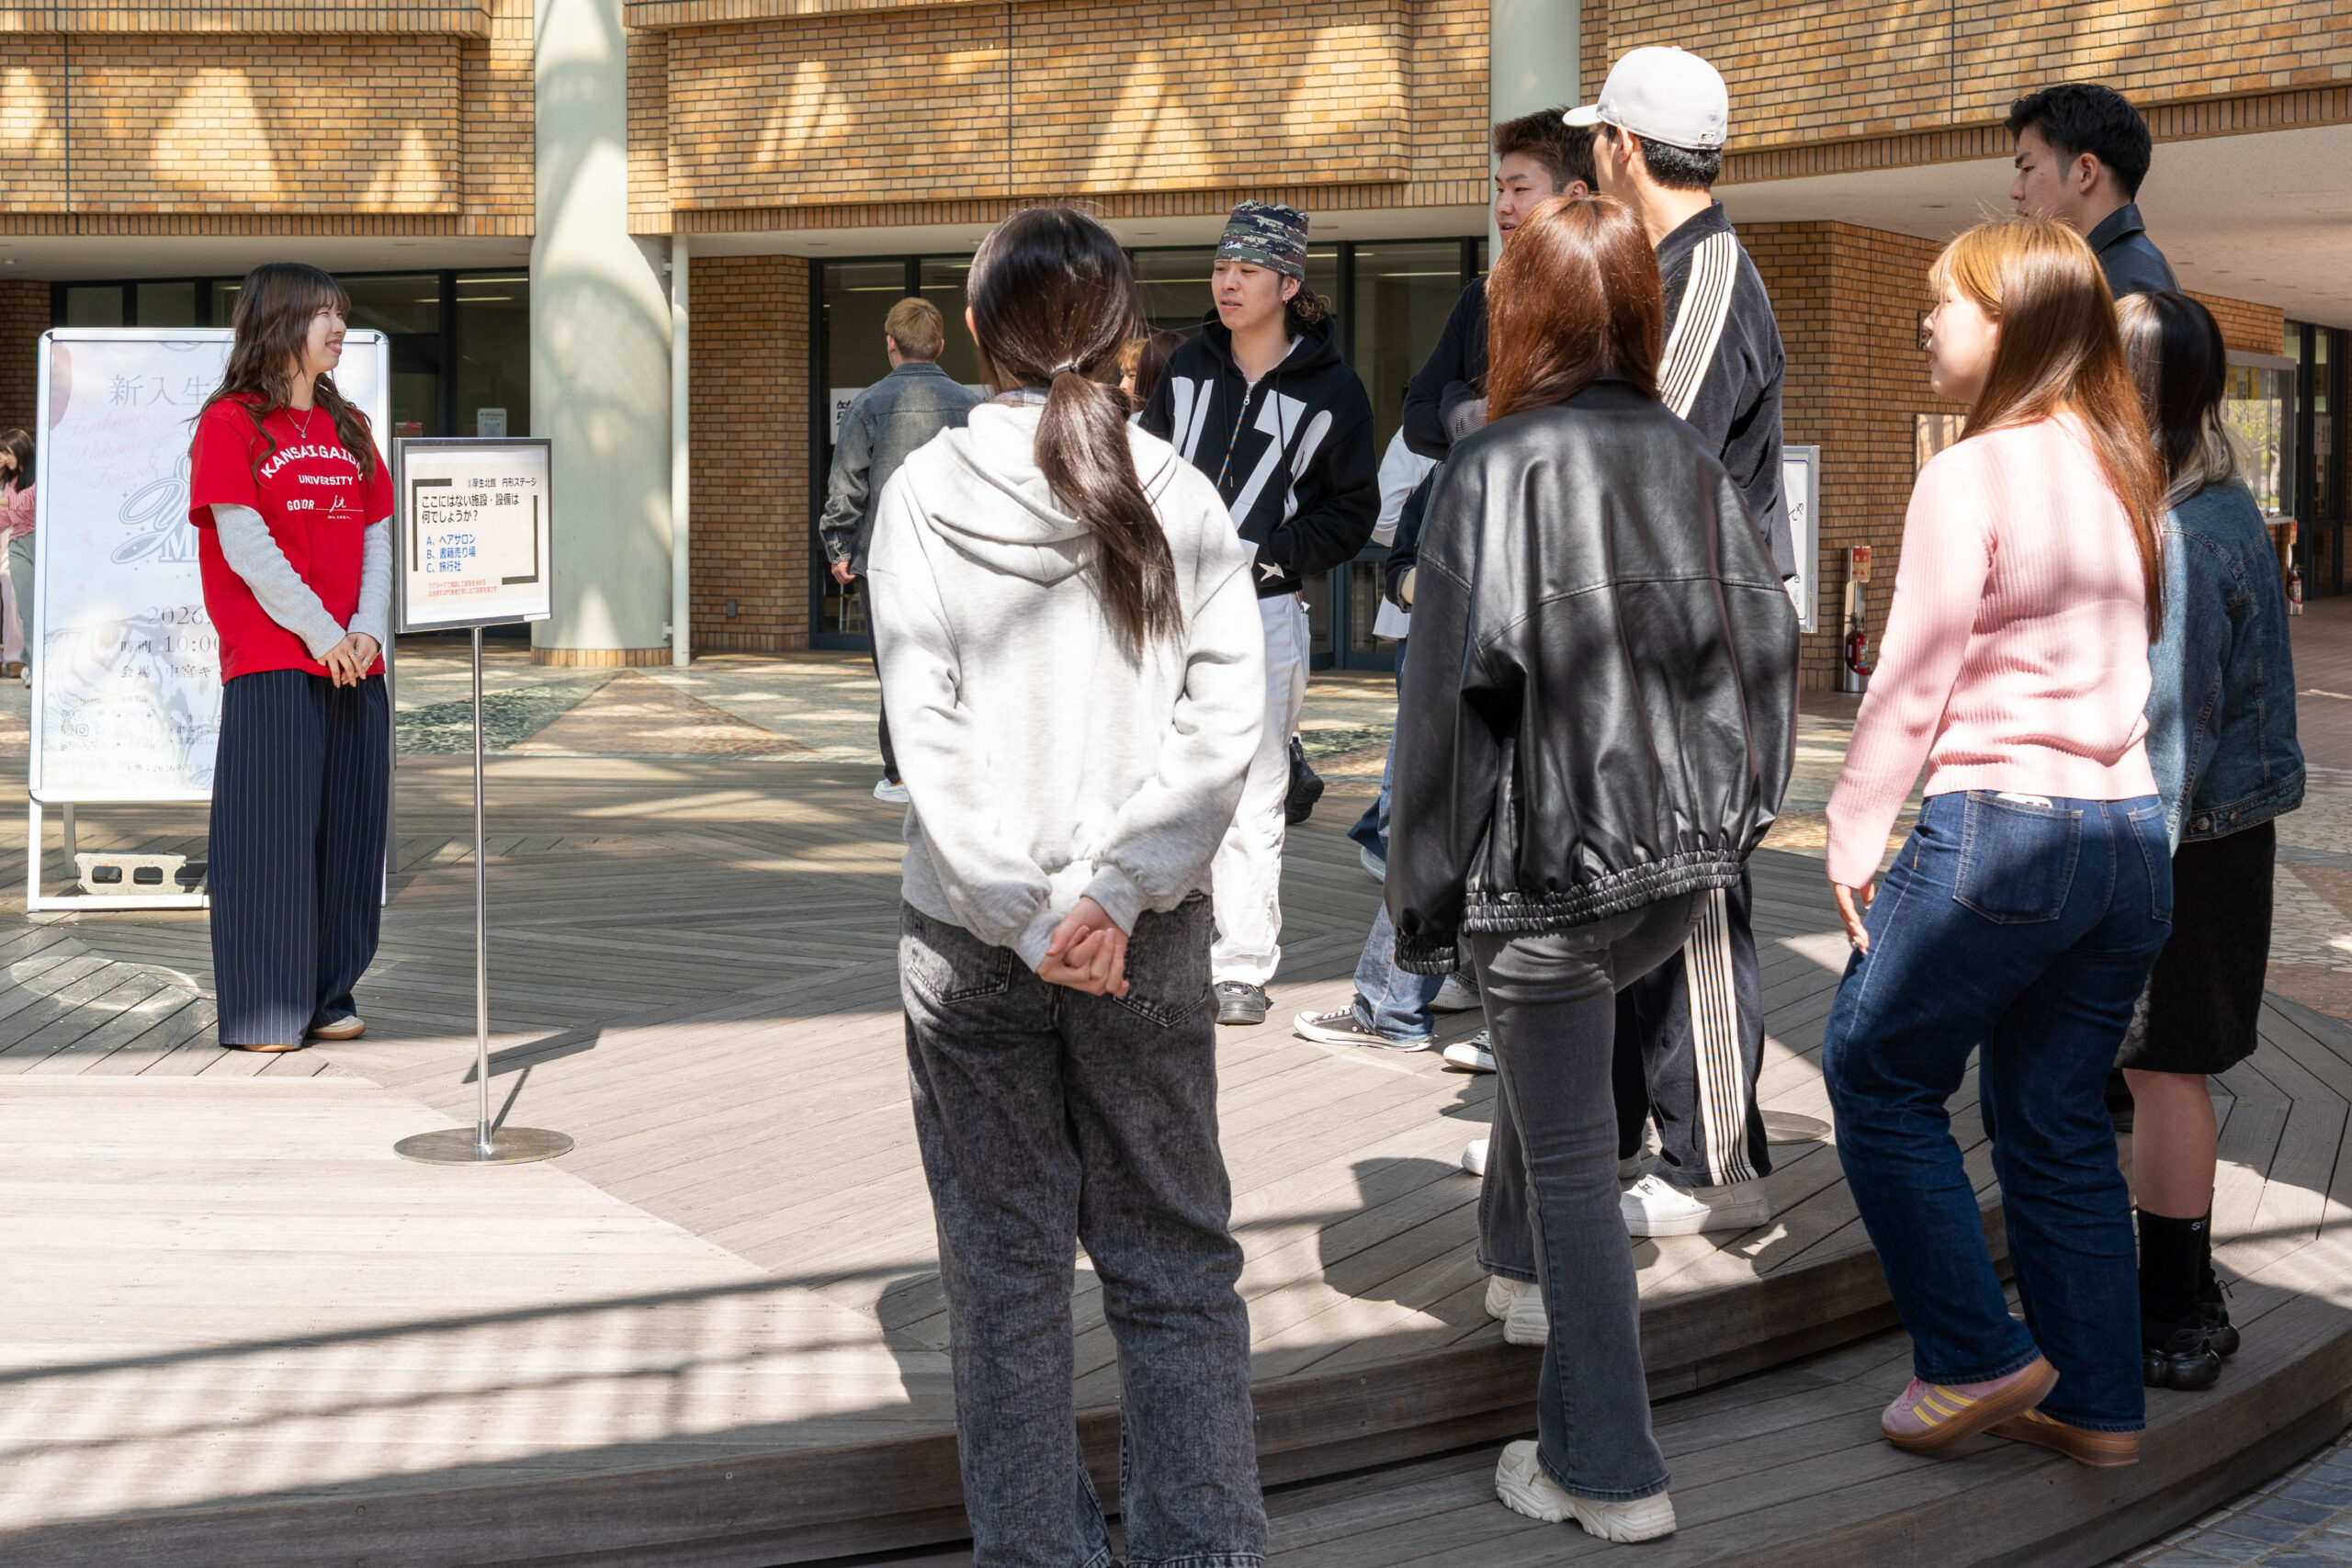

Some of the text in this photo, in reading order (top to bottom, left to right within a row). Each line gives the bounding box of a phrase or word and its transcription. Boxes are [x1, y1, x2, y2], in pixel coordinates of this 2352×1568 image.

[108, 373, 220, 406] 新入生
[260, 445, 363, 481] KANSAI GAID
[299, 474, 353, 486] UNIVERSITY
[502, 477, 537, 487] 円形ステージ
[422, 493, 519, 508] ここにはない施設・設備は
[120, 663, 221, 678] 会場 中宮キ
